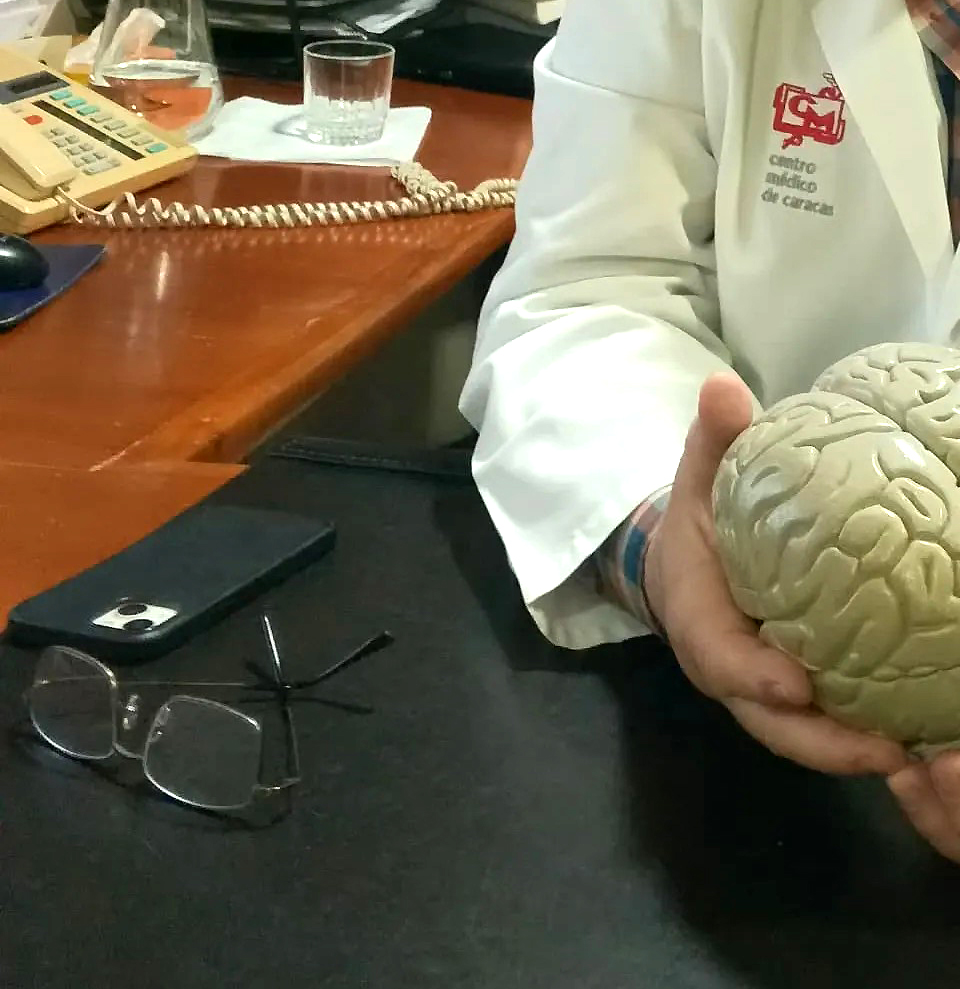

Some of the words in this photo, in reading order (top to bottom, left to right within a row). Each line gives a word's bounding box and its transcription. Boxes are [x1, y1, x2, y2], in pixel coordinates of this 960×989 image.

[768, 154, 817, 174] centro
[760, 188, 780, 205] de
[782, 194, 835, 217] caracas
